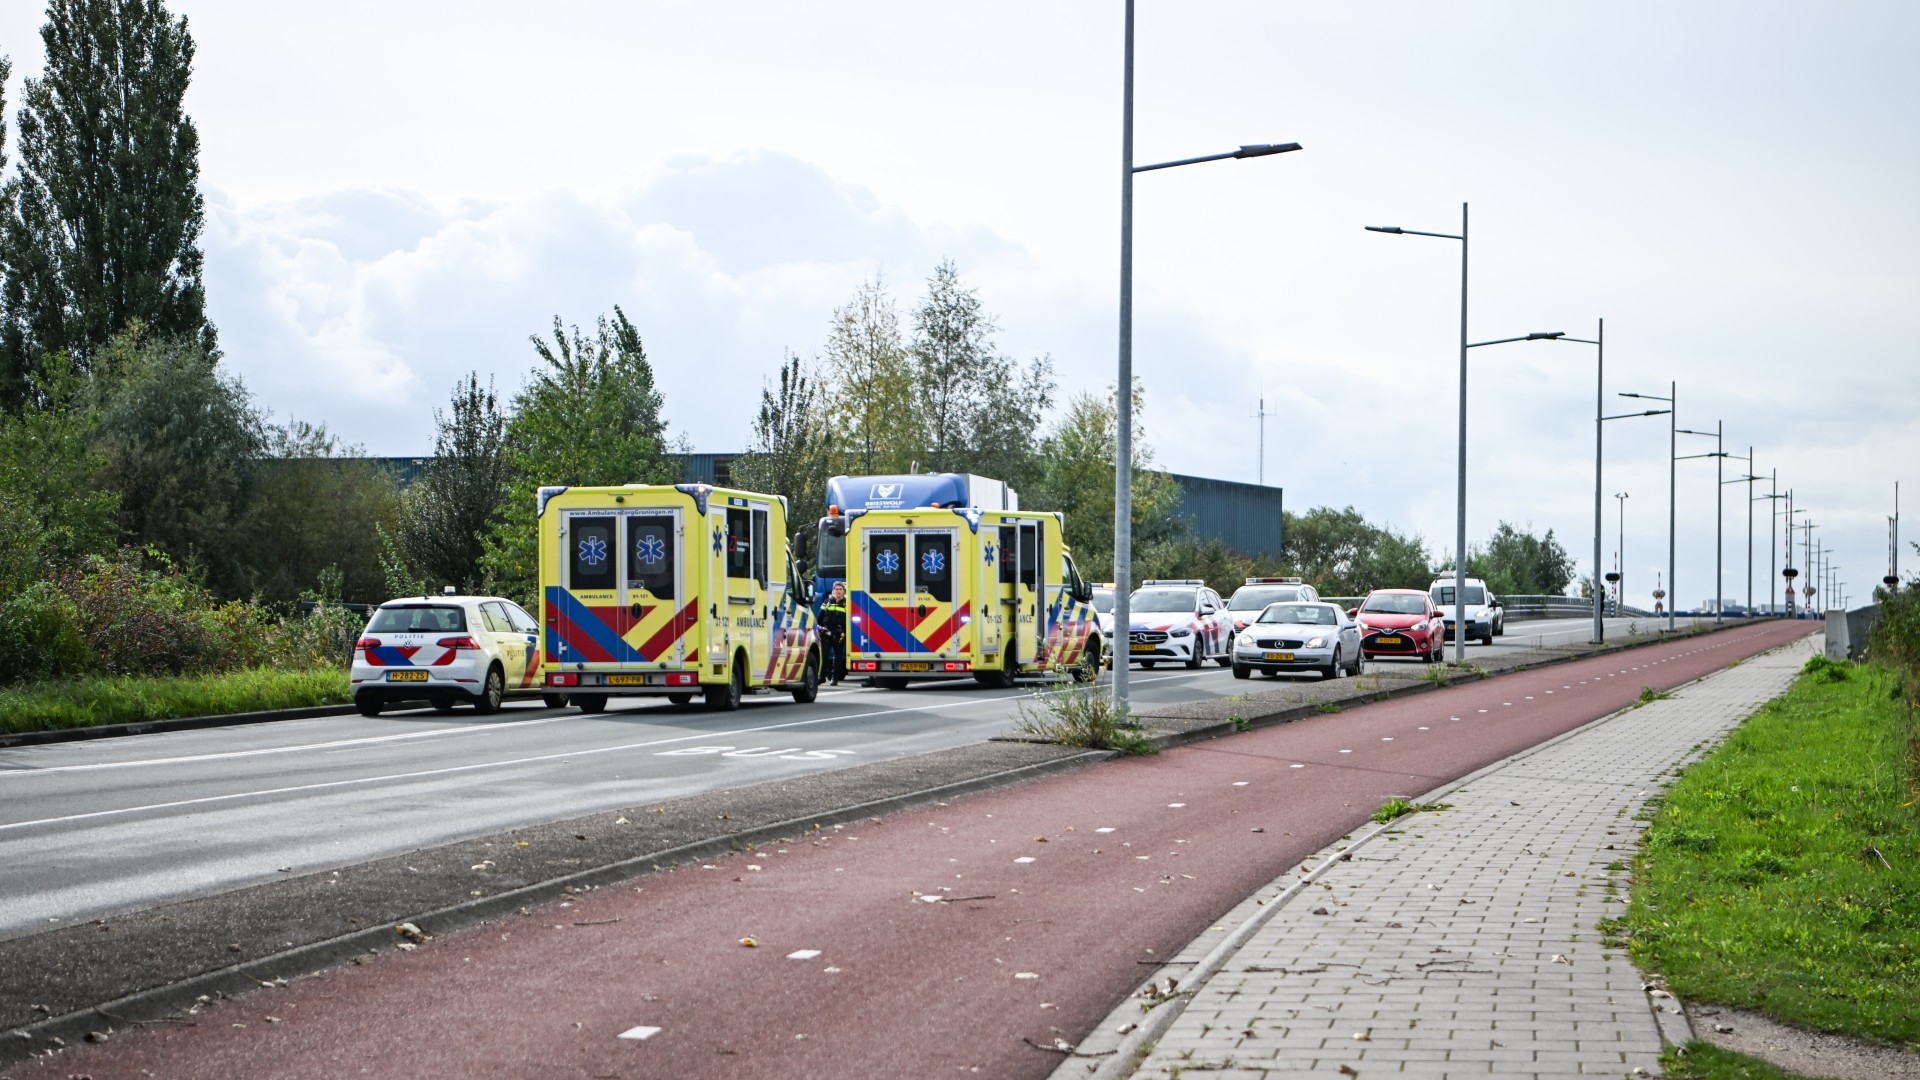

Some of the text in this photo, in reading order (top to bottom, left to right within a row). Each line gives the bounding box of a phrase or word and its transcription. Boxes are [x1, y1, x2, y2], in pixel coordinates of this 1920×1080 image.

[736, 616, 765, 628] AMBULANCE
[608, 675, 642, 684] L-697-PR
[652, 746, 856, 761] BUS
